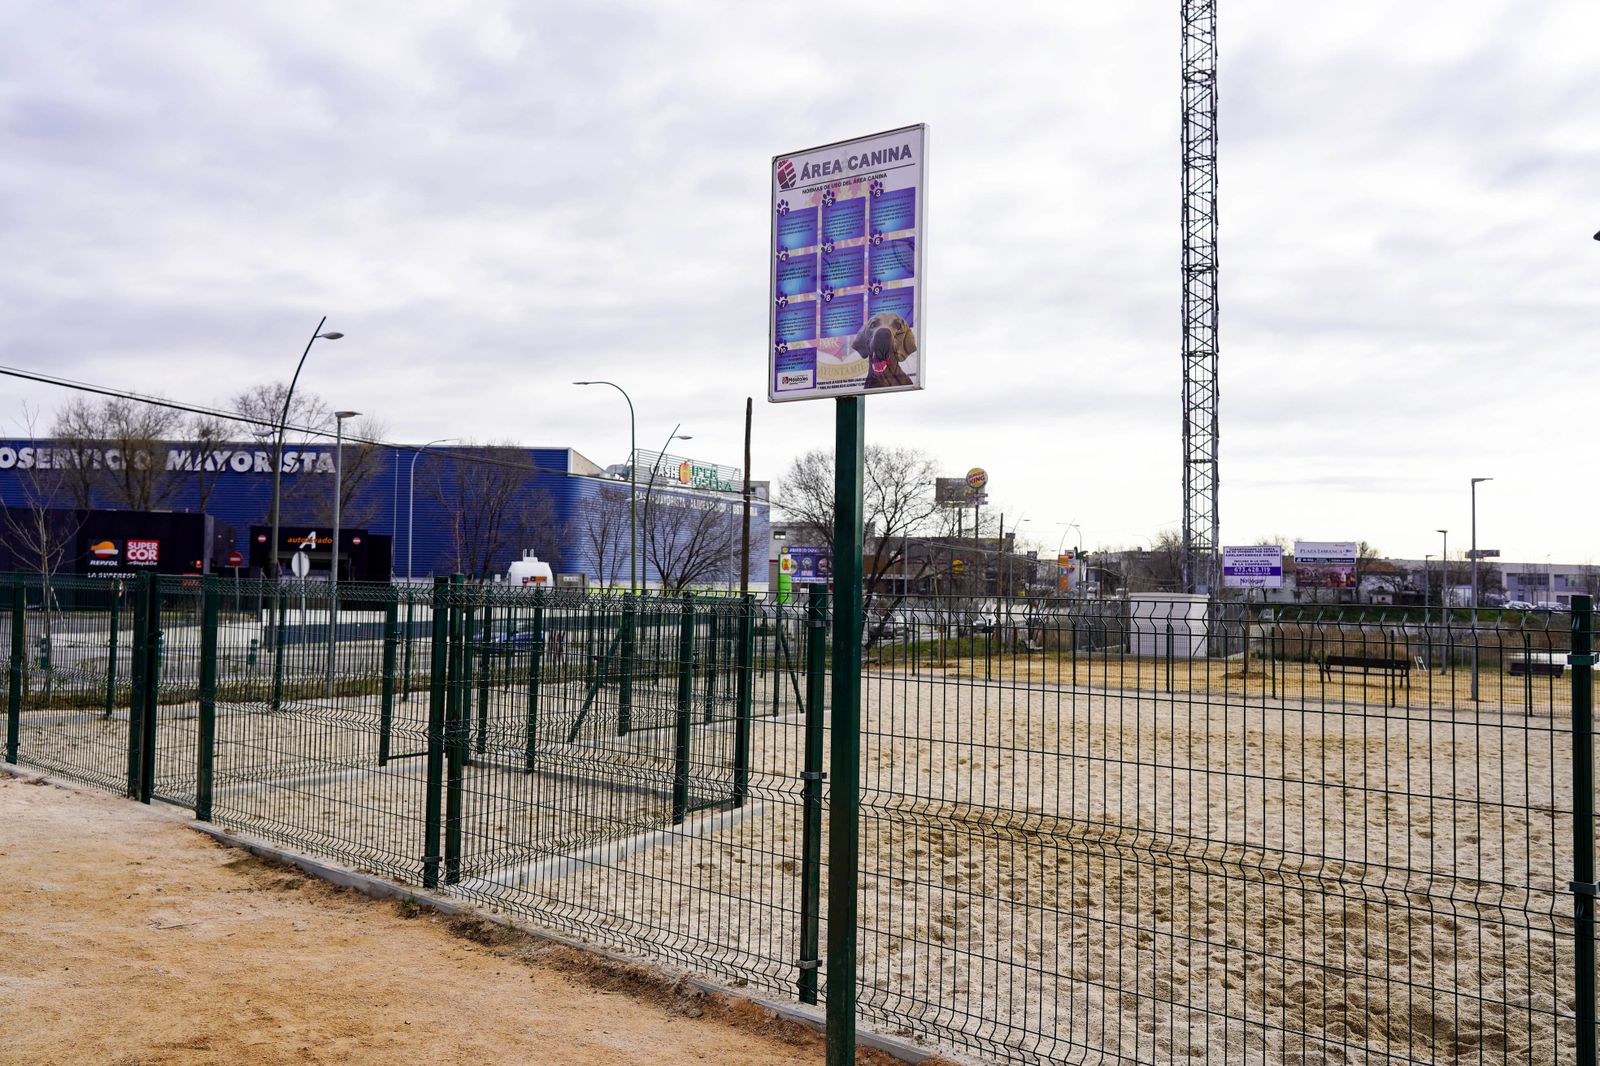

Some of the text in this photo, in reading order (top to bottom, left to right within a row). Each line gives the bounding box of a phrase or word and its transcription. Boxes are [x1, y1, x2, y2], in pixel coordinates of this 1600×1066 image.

[800, 144, 912, 181] ÁREA CANINA
[802, 186, 823, 194] NORMAS
[867, 173, 888, 182] CANINA
[649, 463, 678, 480] CASH
[969, 474, 985, 485] KING
[127, 541, 158, 550] SUPER
[127, 549, 158, 561] COR
